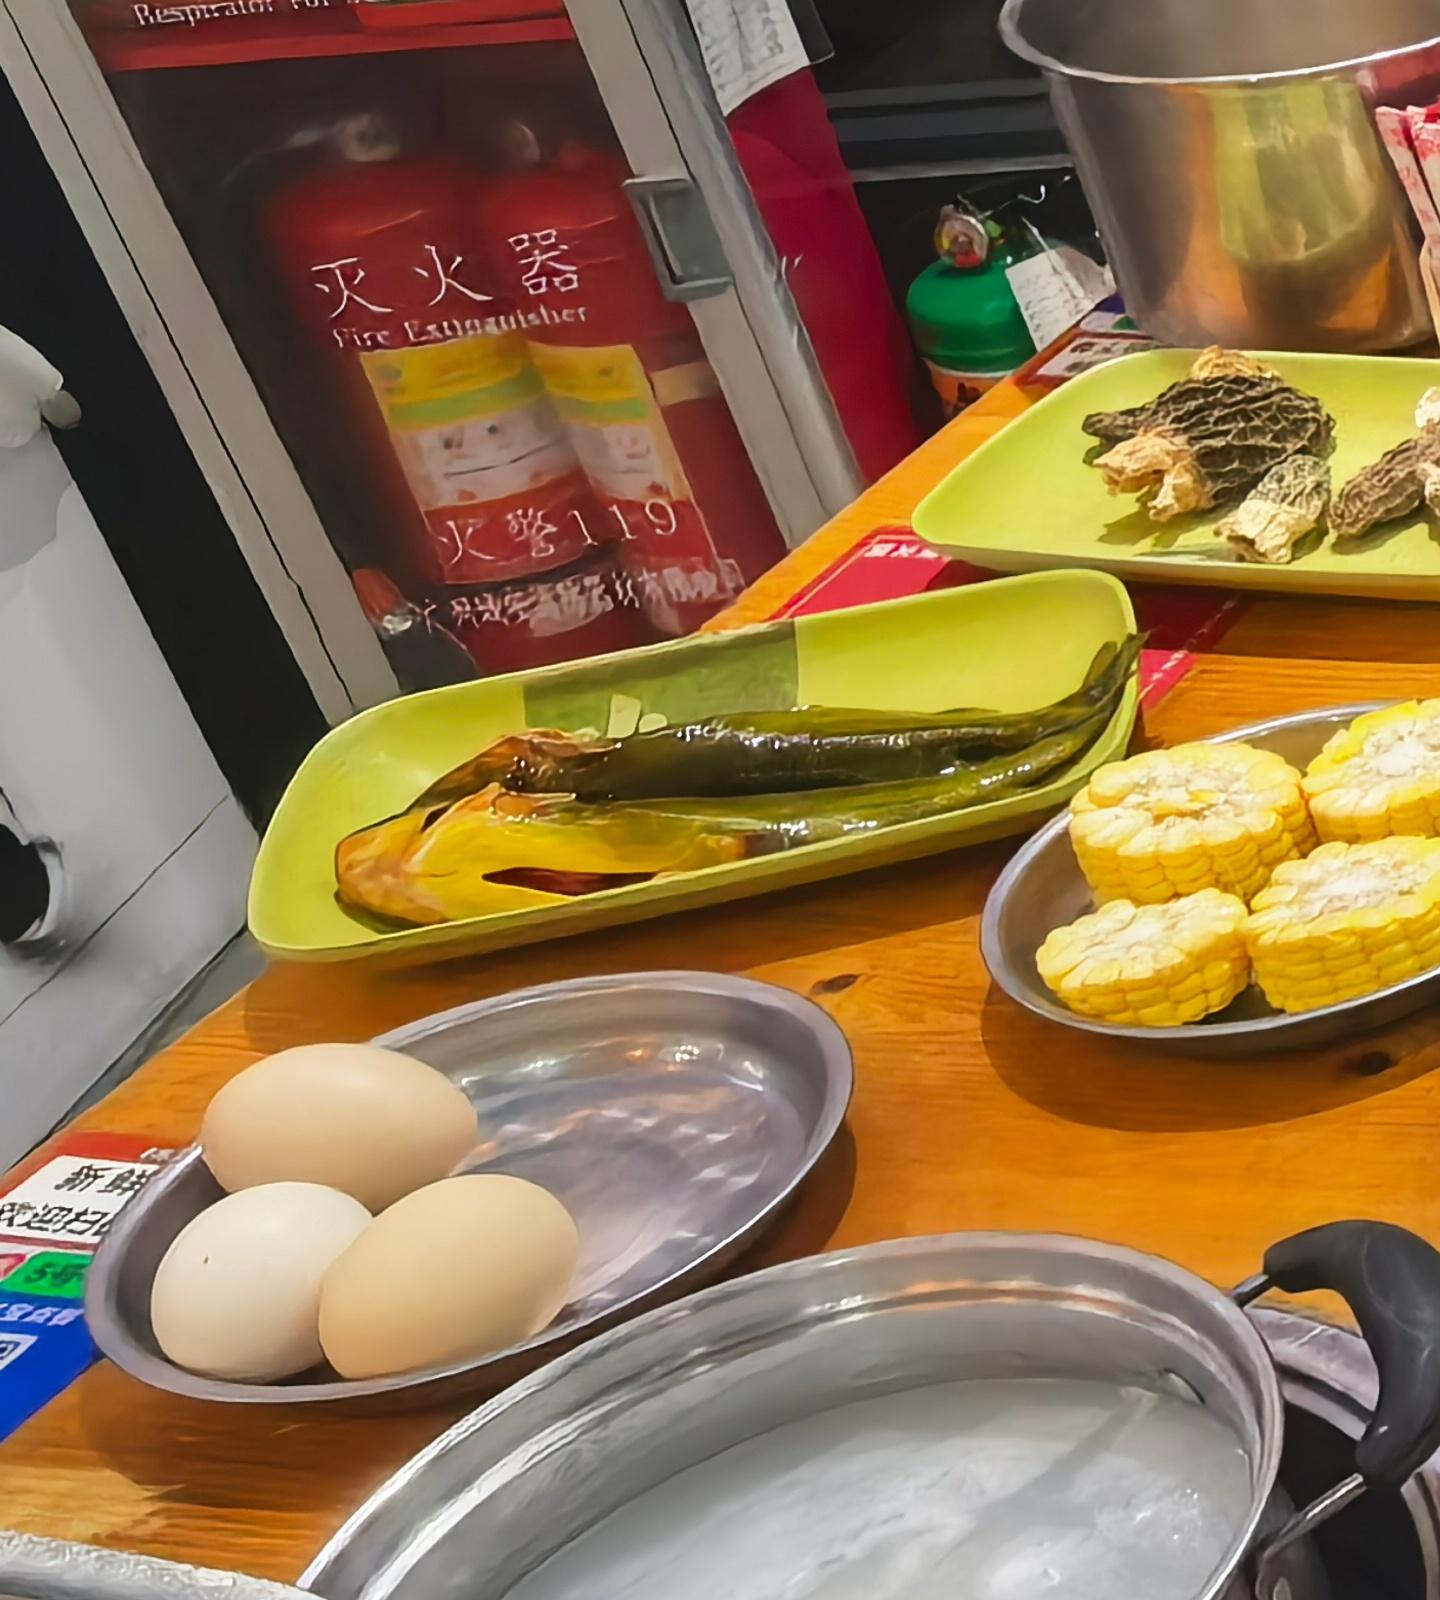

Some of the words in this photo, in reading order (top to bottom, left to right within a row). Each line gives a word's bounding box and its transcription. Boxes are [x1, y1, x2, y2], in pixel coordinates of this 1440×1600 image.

[310, 228, 579, 318] 灭火器
[332, 326, 391, 348] Fire
